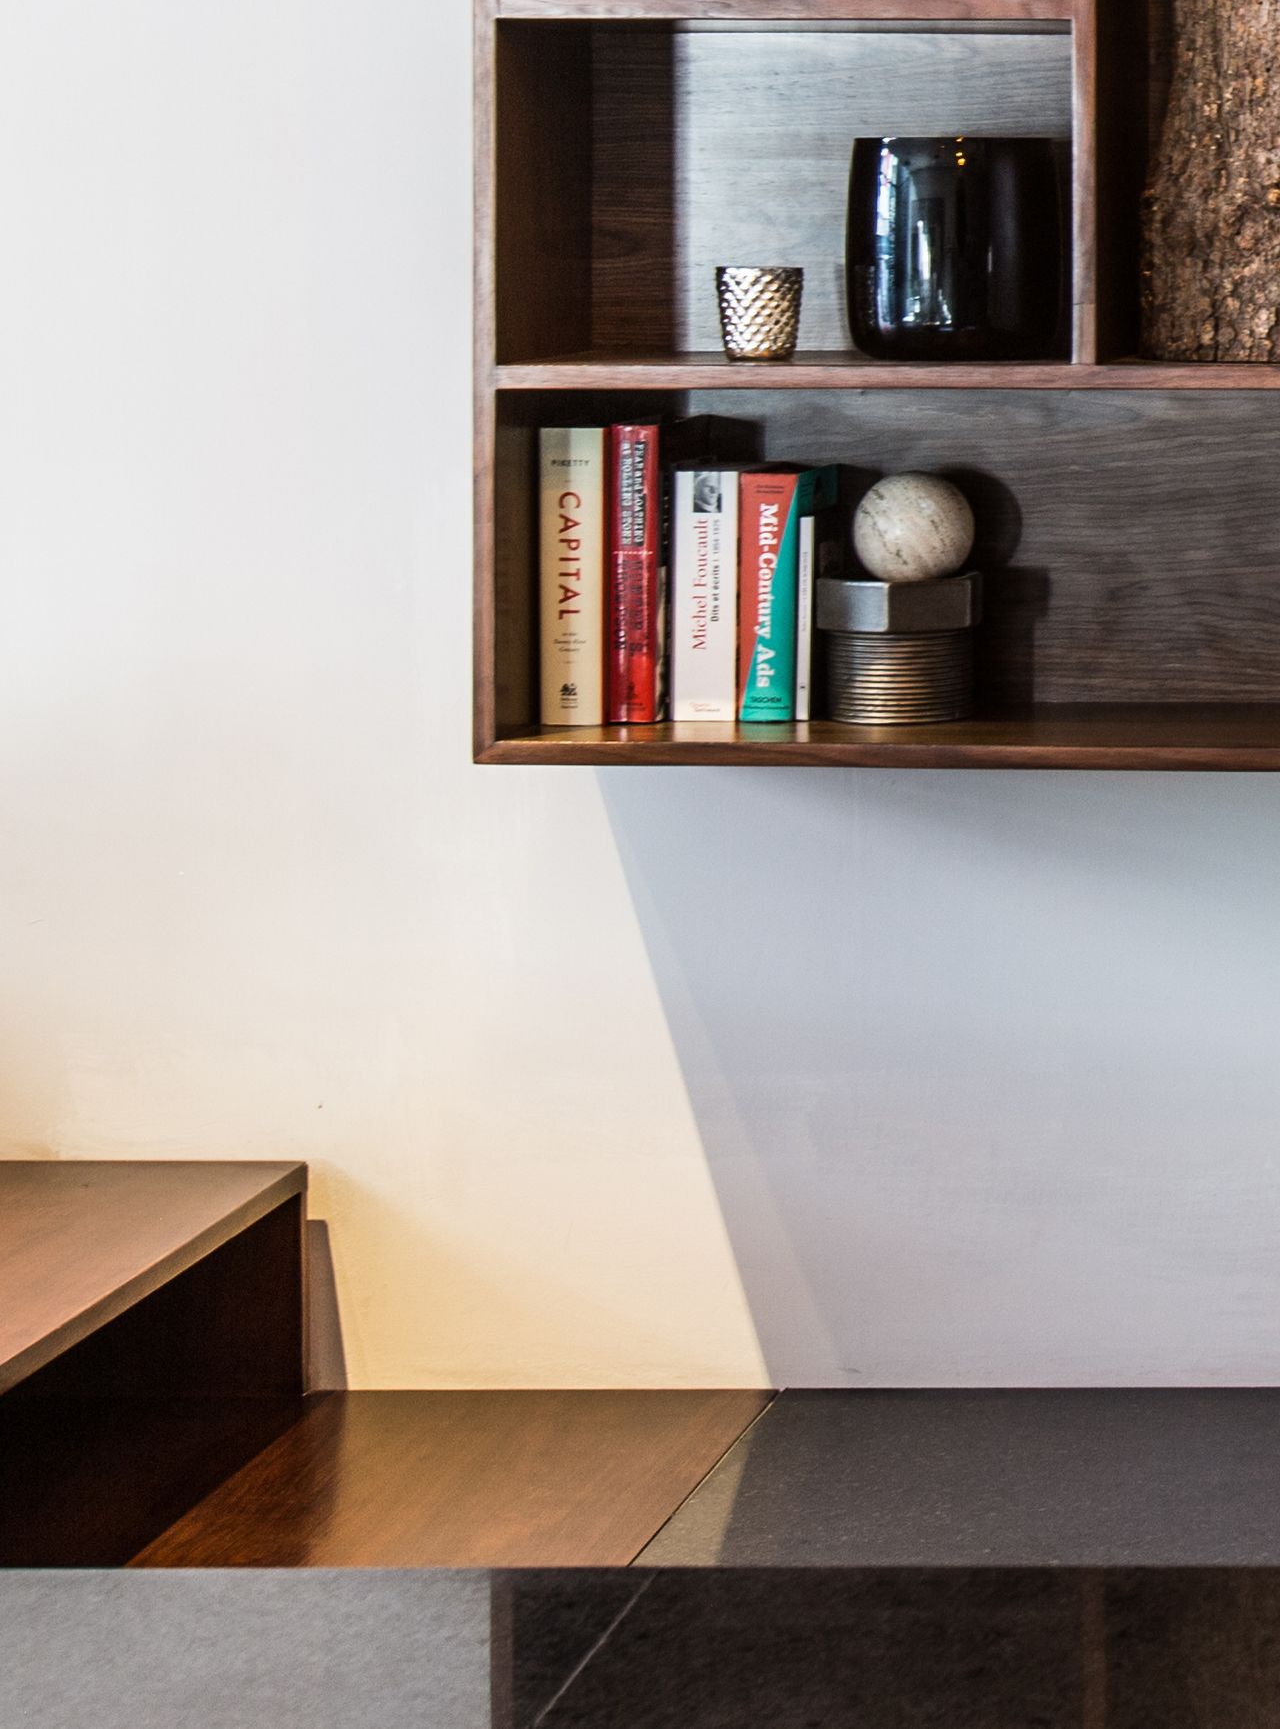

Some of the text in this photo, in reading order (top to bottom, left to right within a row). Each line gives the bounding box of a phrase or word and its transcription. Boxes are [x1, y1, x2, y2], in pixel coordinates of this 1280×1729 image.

[558, 491, 582, 620] CAPITAL
[692, 518, 709, 651] Michel Foucault
[753, 503, 779, 639] Mid-Century
[711, 604, 720, 622] Dits
[750, 696, 782, 704] TASCHEN
[756, 644, 776, 688] Ads
